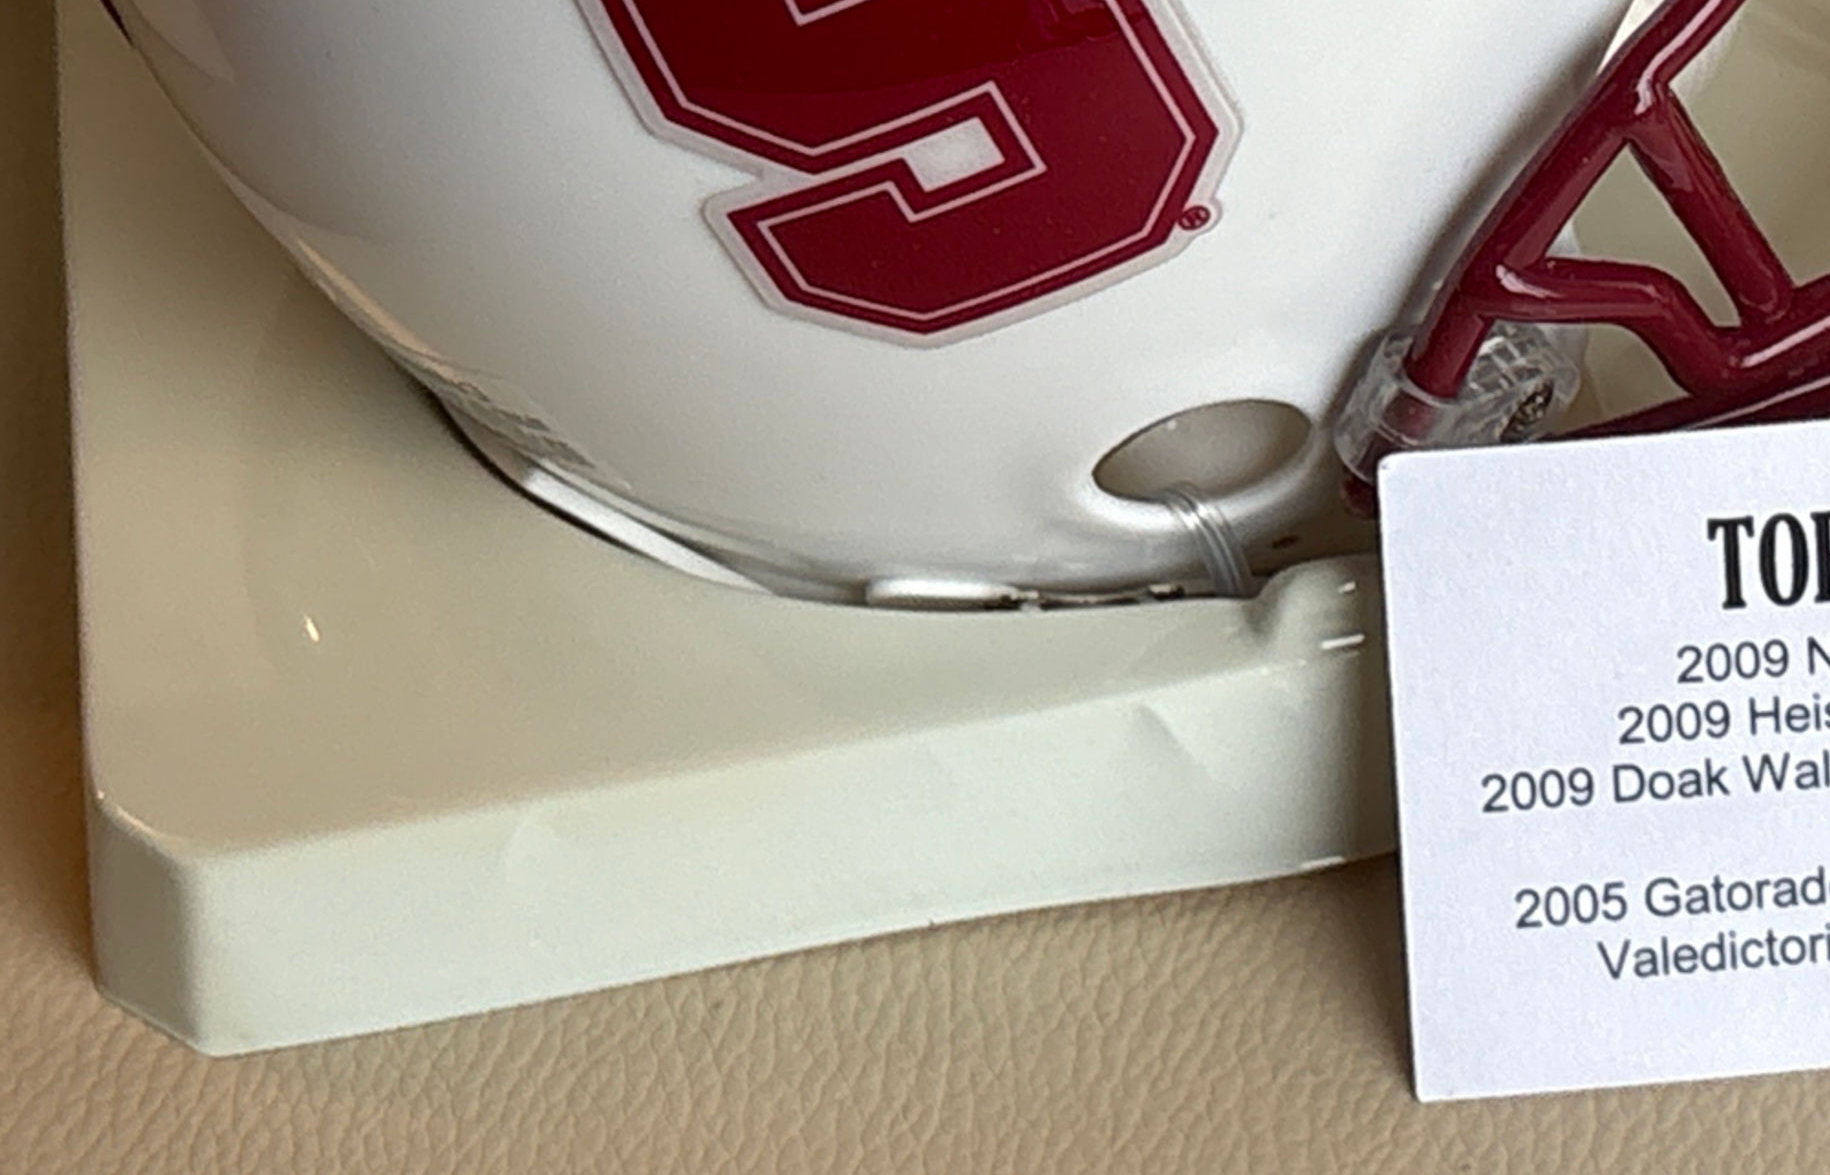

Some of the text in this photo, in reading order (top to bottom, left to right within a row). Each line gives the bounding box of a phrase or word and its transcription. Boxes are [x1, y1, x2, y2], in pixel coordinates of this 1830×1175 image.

[1677, 639, 1790, 684] 2009
[1618, 700, 1731, 745] 2009
[1481, 767, 1594, 813] 2009
[1612, 758, 1730, 803] Doak
[1515, 881, 1628, 929] 2005
